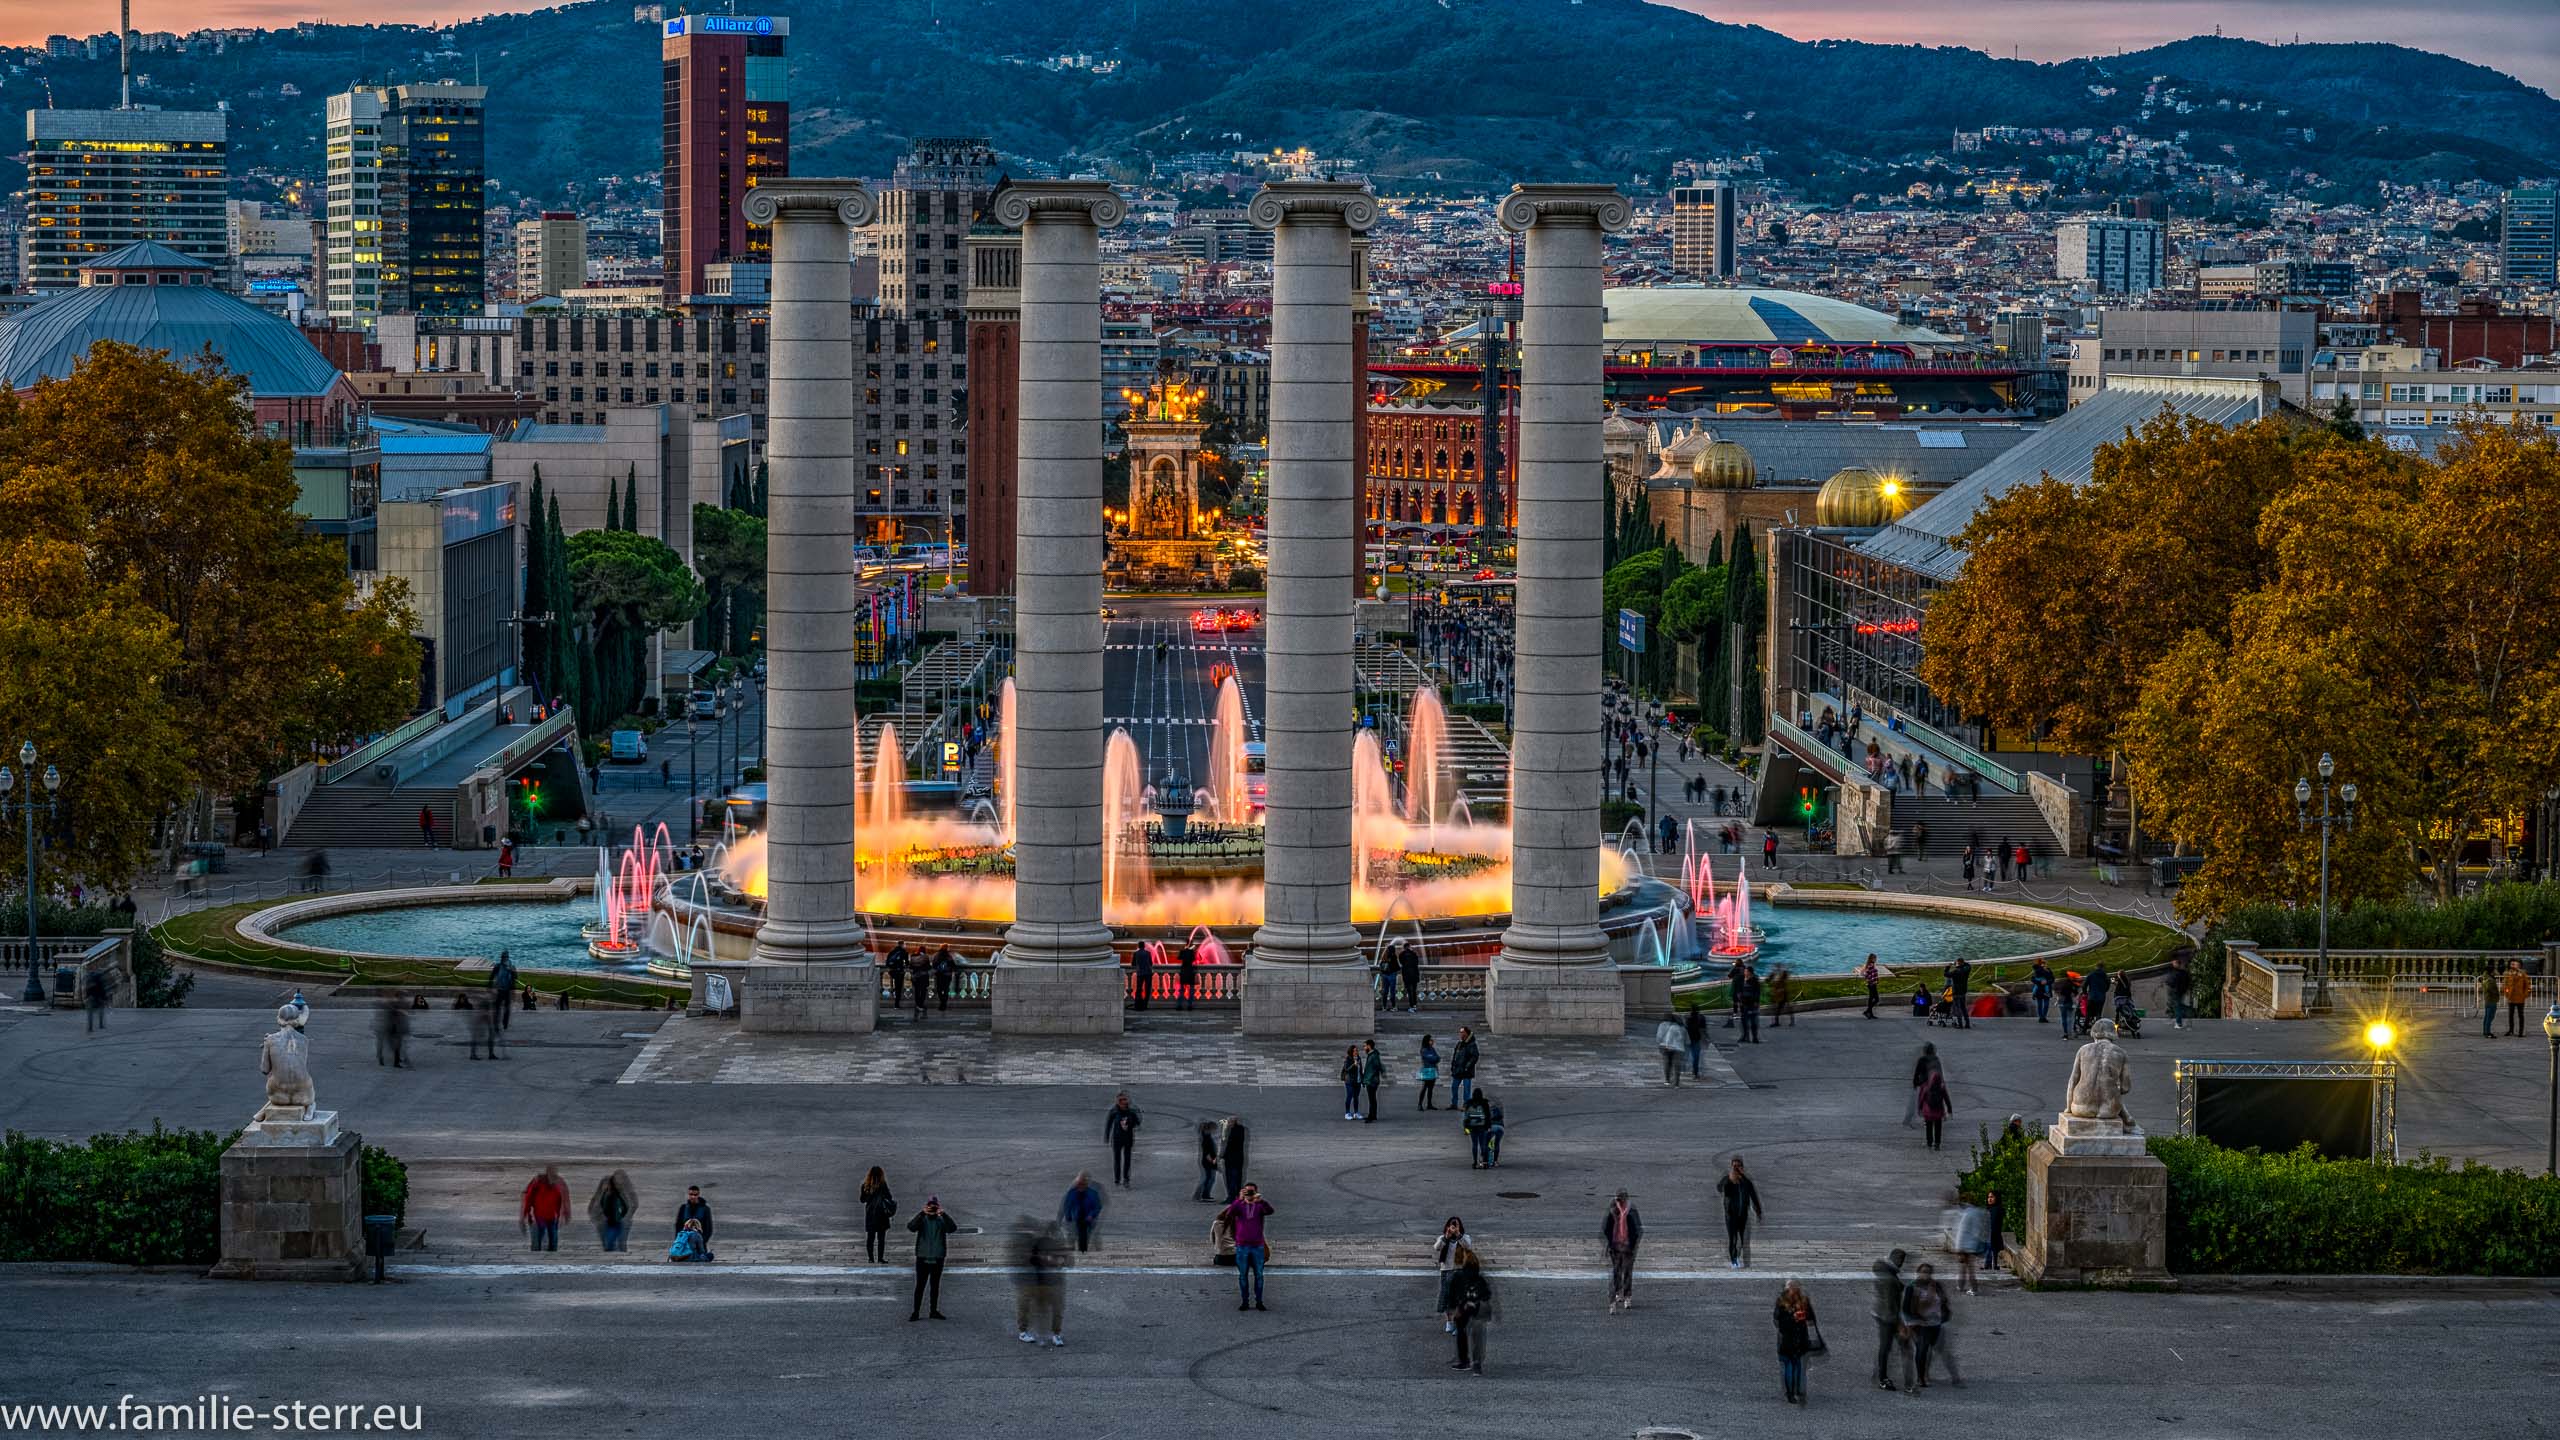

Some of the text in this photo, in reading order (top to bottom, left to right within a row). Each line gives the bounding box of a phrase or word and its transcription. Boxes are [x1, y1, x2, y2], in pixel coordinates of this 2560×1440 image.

[705, 18, 754, 31] Allianz
[924, 152, 998, 166] PLAZA
[938, 171, 984, 179] HOTEL
[944, 742, 959, 761] P
